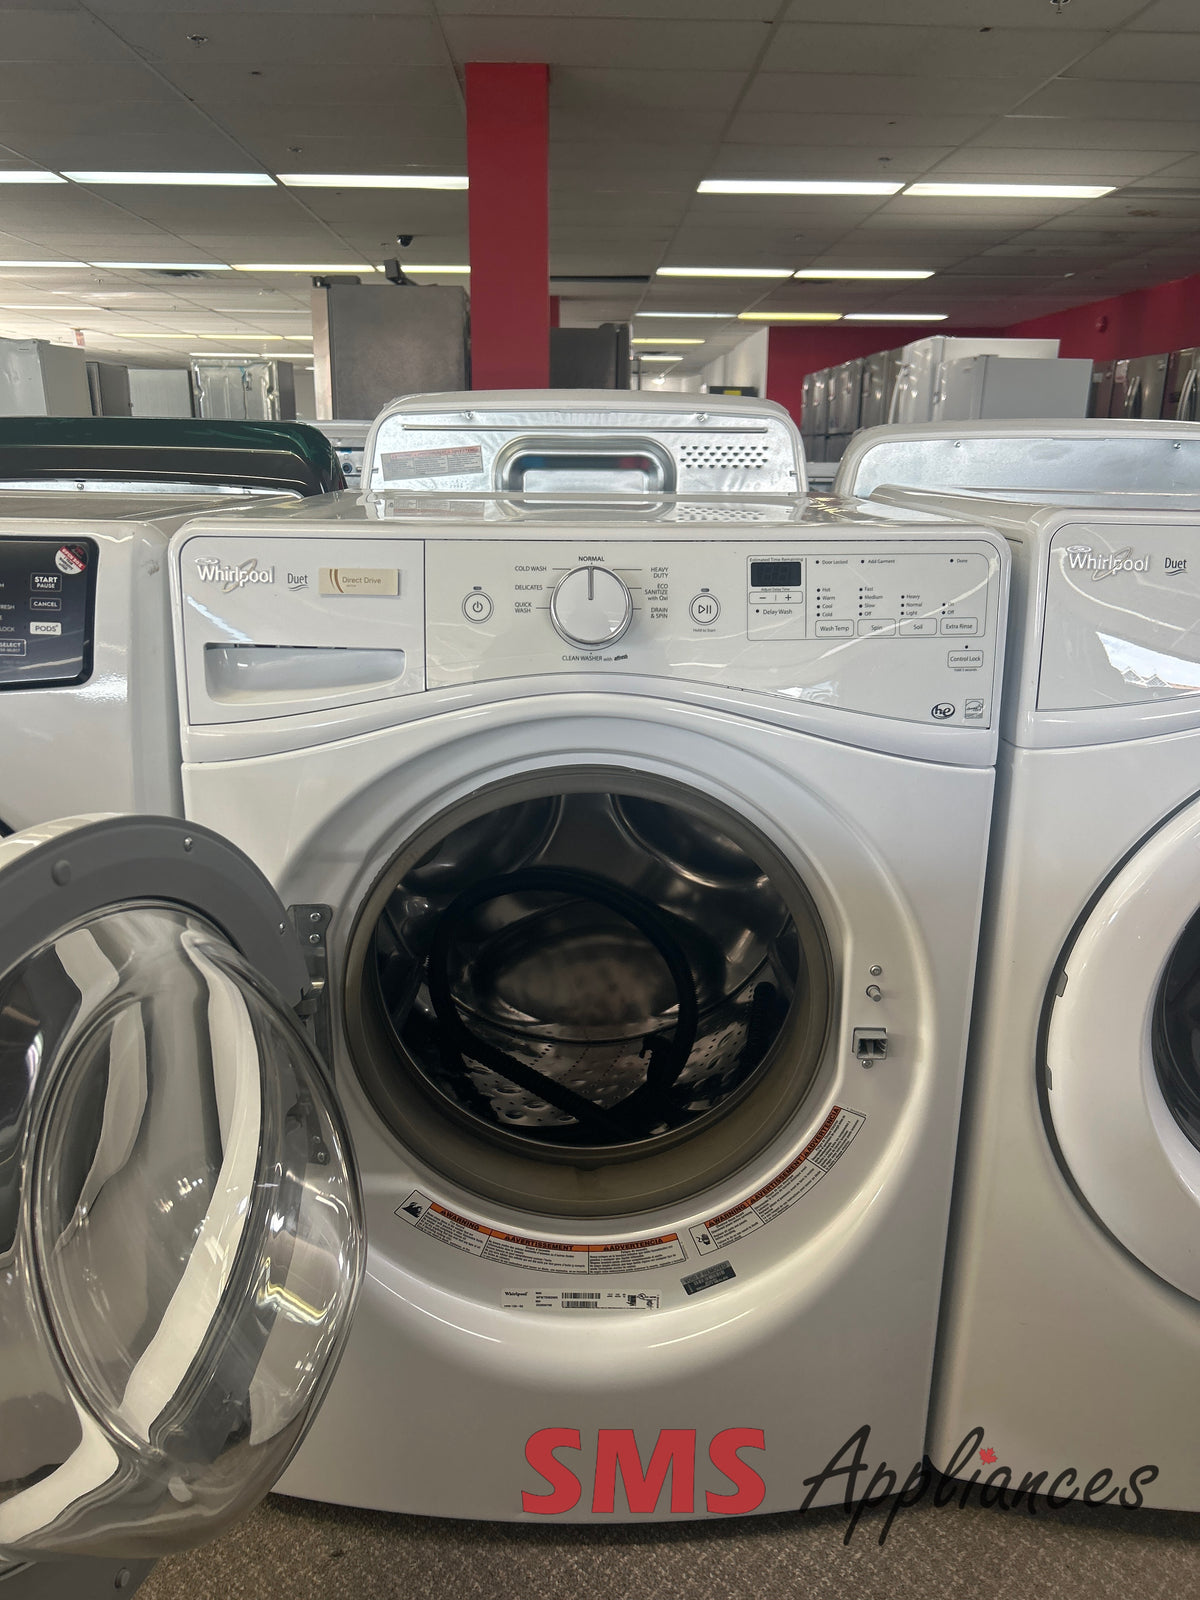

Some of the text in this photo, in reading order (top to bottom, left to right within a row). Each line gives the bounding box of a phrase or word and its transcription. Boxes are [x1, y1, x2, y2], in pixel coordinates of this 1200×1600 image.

[1068, 554, 1187, 574] Whirlpool Duet
[197, 564, 308, 587] Whirlpool Duet
[806, 1108, 840, 1152] ADVERTENCIA
[754, 1156, 802, 1200] AVERTISSEMENT
[446, 1210, 480, 1230] WARNING
[714, 1204, 746, 1222] WARNING
[510, 1236, 572, 1250] AVERTISSEMENT
[610, 1238, 664, 1251] ADVERTENCIA
